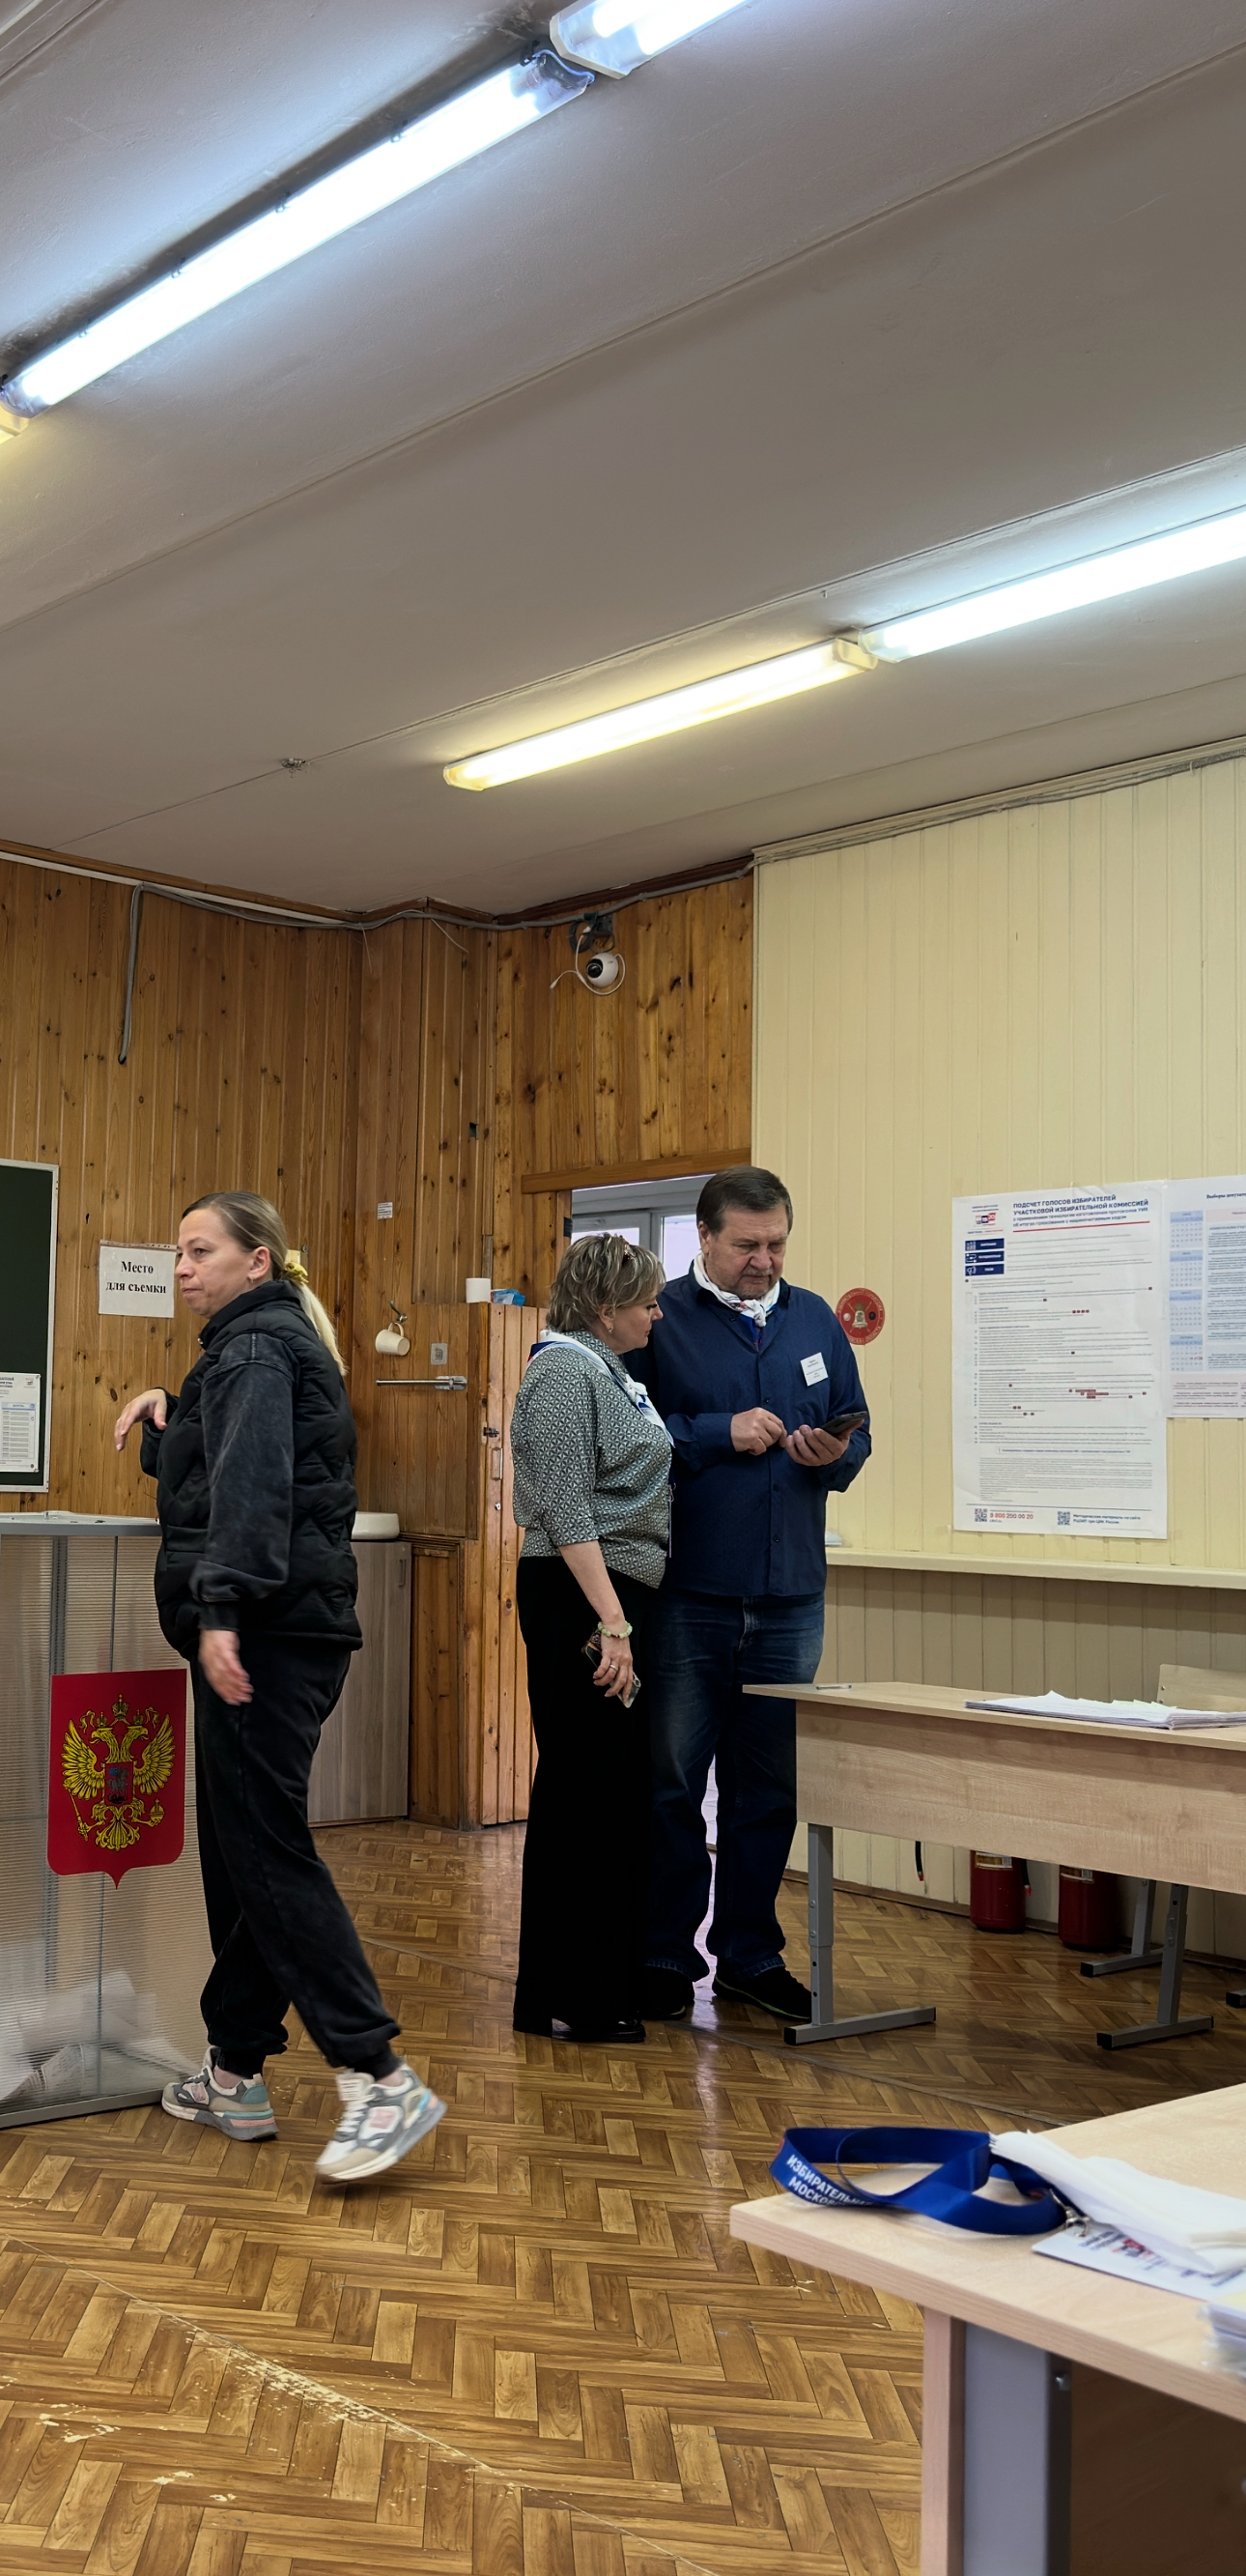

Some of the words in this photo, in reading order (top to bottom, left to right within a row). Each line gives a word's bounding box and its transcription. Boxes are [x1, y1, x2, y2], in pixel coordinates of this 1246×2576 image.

[1072, 1194, 1116, 1204] ИЗБИРАТЕЛЕЙ
[1013, 1207, 1053, 1216] УЧАСТКОВОЙ
[1055, 1203, 1107, 1213] ИЗБИРАТЕЛЬНОЙ
[1109, 1199, 1148, 1208] КОМИССИЕЙ
[121, 1261, 154, 1274] Место
[106, 1282, 126, 1291] для
[128, 1283, 166, 1294] съемки
[788, 2176, 841, 2206] МОСКОВ
